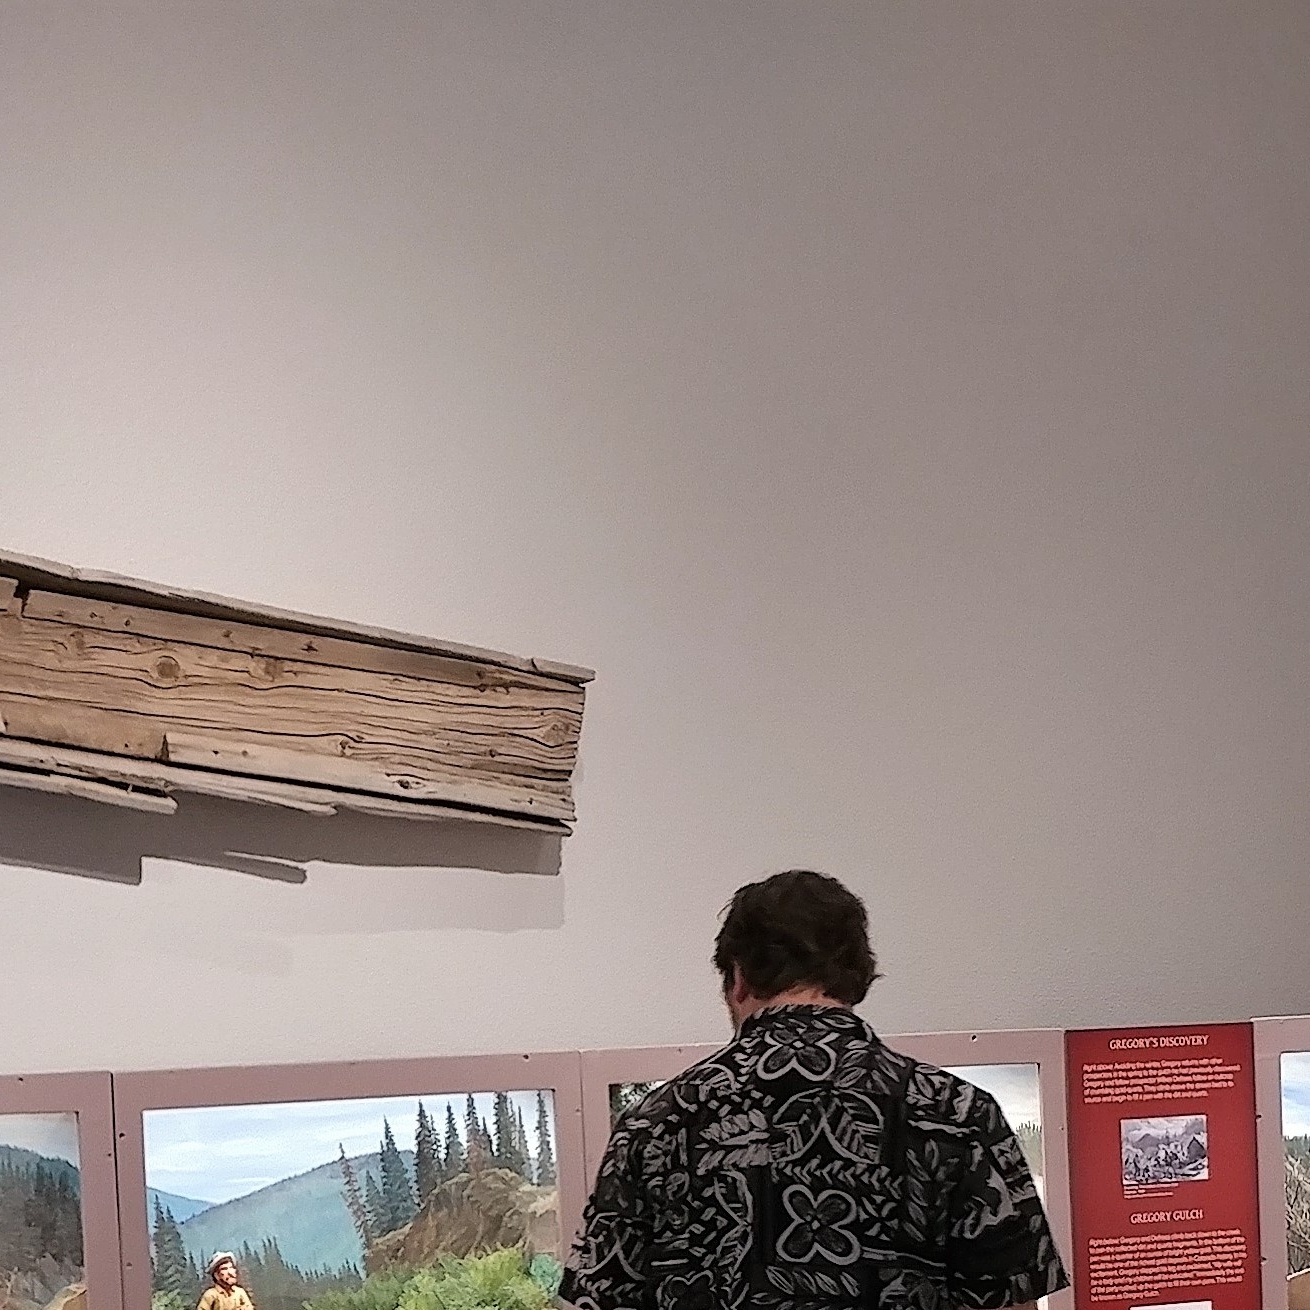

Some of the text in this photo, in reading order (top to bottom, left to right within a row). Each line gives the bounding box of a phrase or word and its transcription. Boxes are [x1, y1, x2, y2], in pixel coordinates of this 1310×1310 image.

[1109, 1035, 1209, 1050] GREGORY'S DISCOVERY
[1130, 1209, 1204, 1224] GREGORY GULCH
